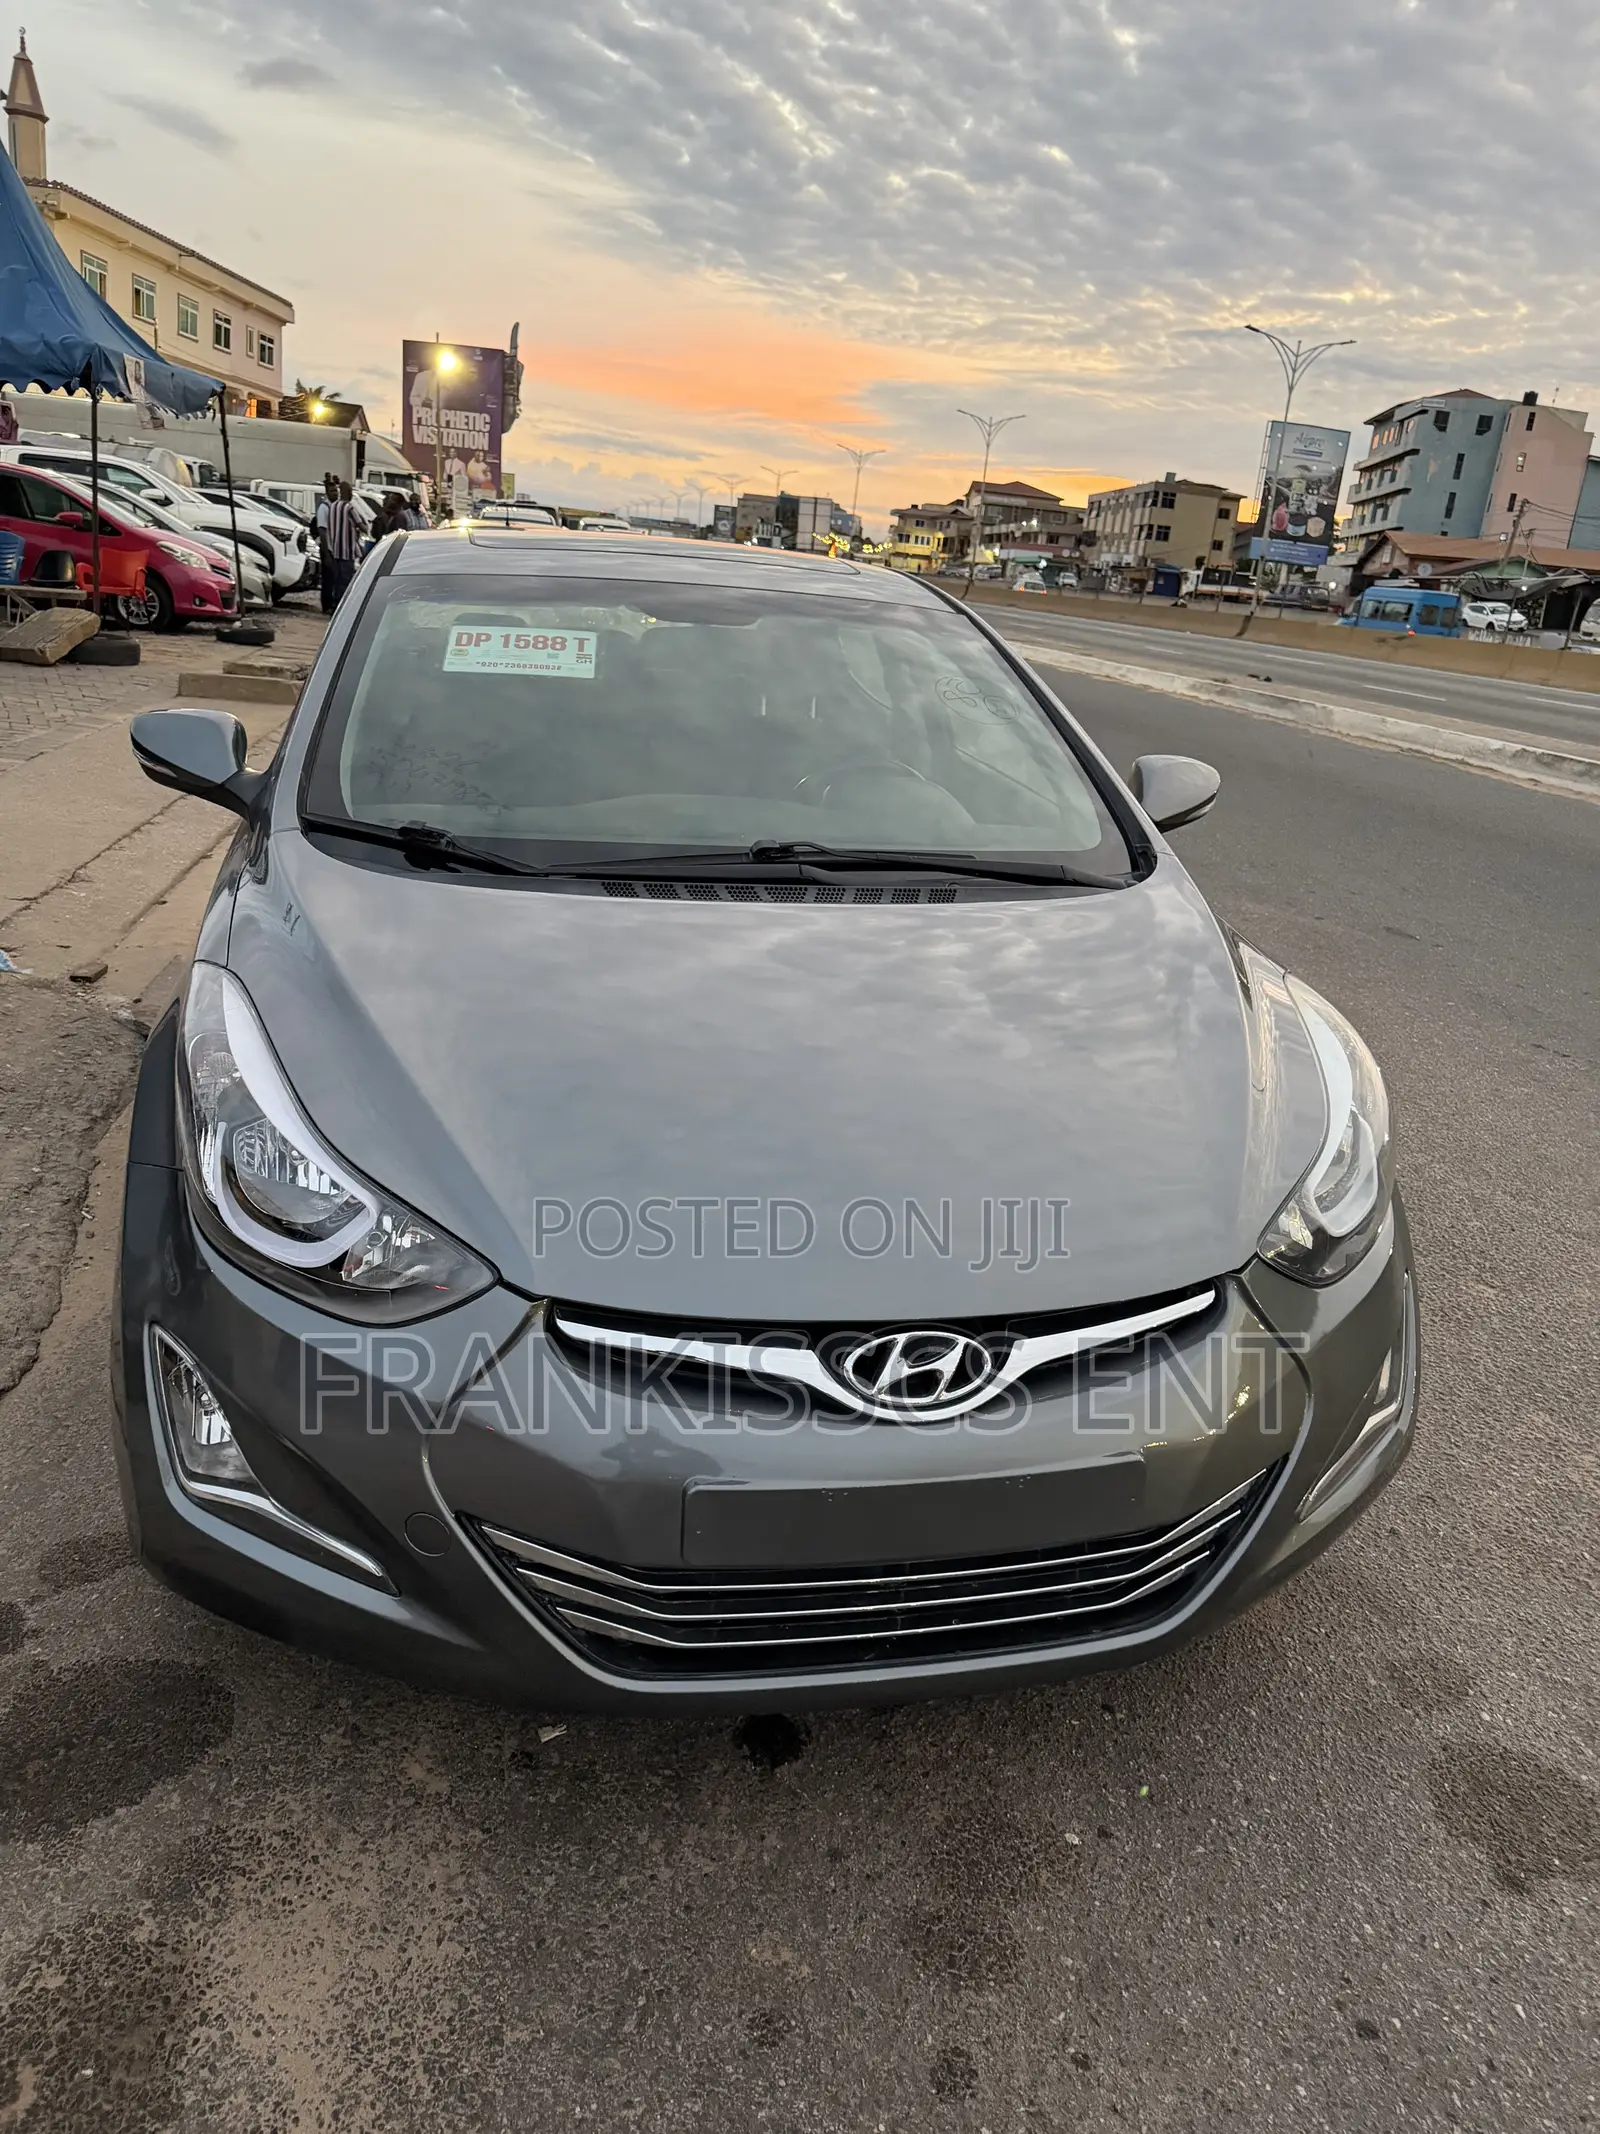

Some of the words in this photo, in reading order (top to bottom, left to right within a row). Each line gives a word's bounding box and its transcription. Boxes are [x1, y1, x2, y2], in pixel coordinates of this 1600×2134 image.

[412, 424, 489, 450] VISTATION
[455, 632, 492, 647] DP
[500, 633, 567, 651] 1588
[573, 637, 590, 652] T
